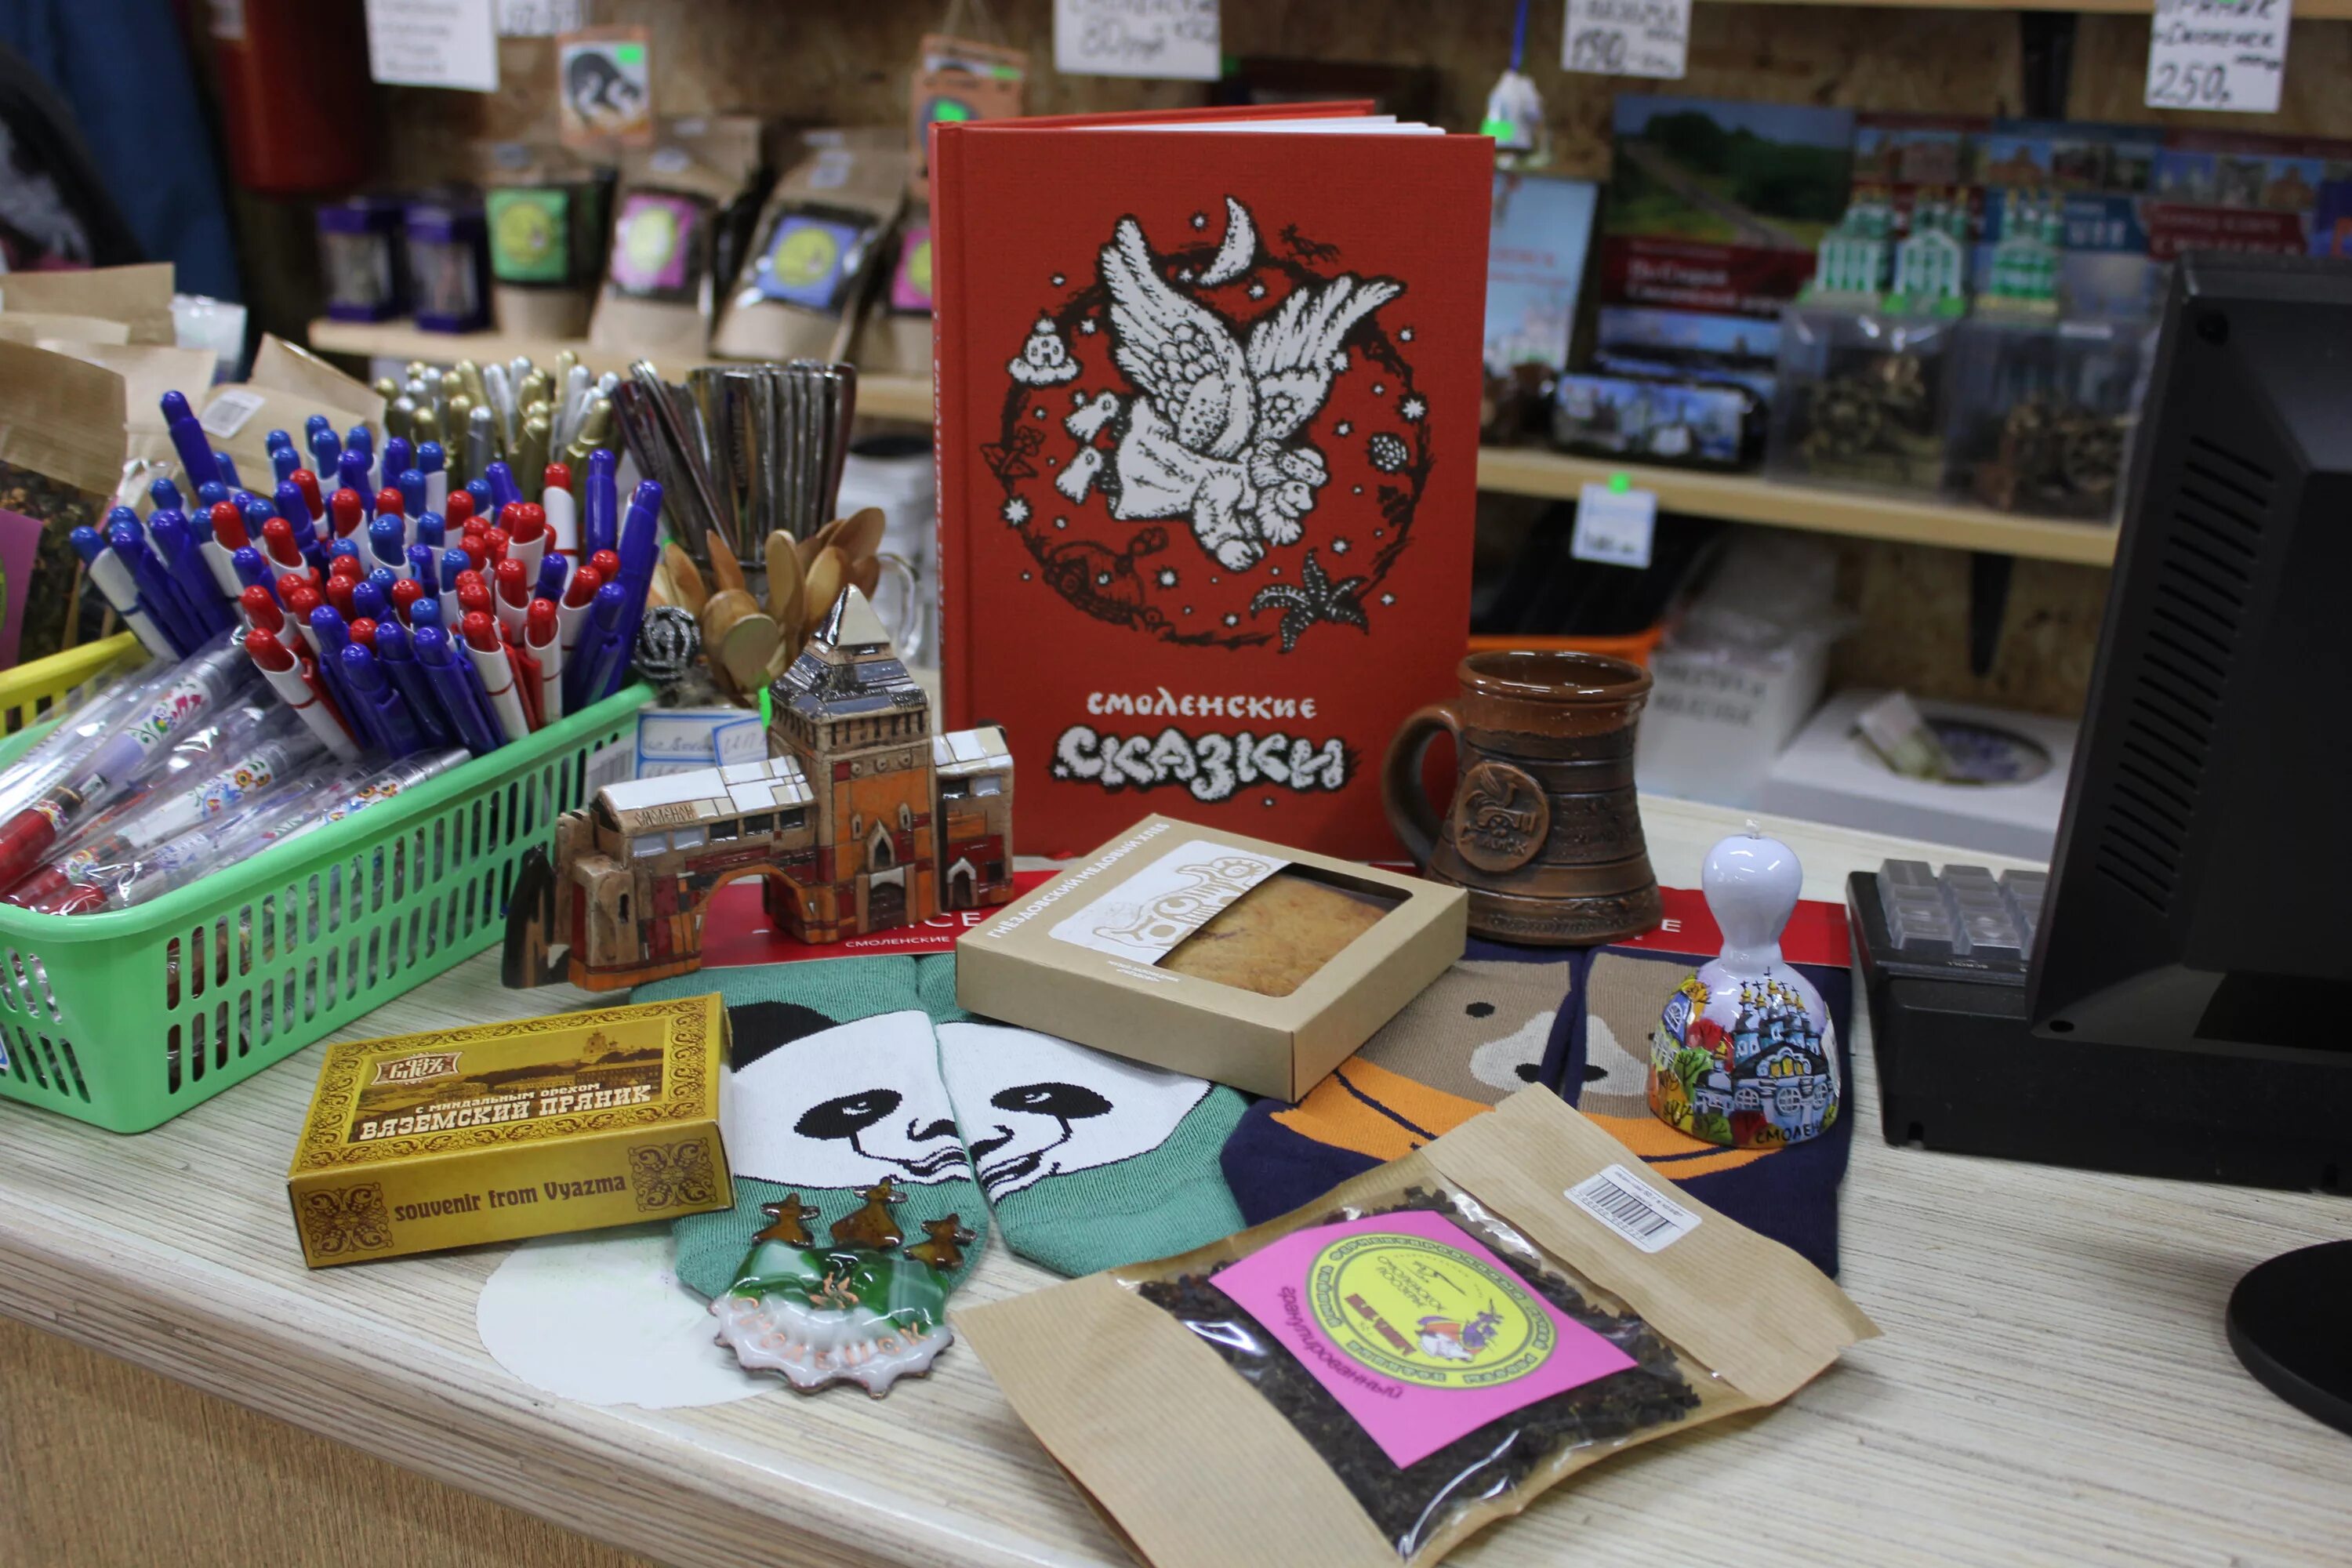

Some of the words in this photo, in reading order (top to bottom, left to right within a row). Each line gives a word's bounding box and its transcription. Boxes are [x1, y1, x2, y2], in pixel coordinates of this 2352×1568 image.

[1056, 724, 1345, 801] СКАЗКИ
[1076, 840, 1138, 885] МЕДОВЫЙ
[1137, 822, 1171, 843] ХЛЕБ
[845, 935, 950, 949] СМОЛЕНСКИЕ
[359, 1100, 529, 1141] ВЯЗЕМСКИЙ
[539, 1083, 652, 1115] ПРЯНИК
[428, 1091, 535, 1113] миндальным
[540, 1081, 601, 1098] орехом
[394, 1193, 481, 1222] souvenir
[488, 1187, 539, 1209] from
[543, 1174, 627, 1201] Vyazma
